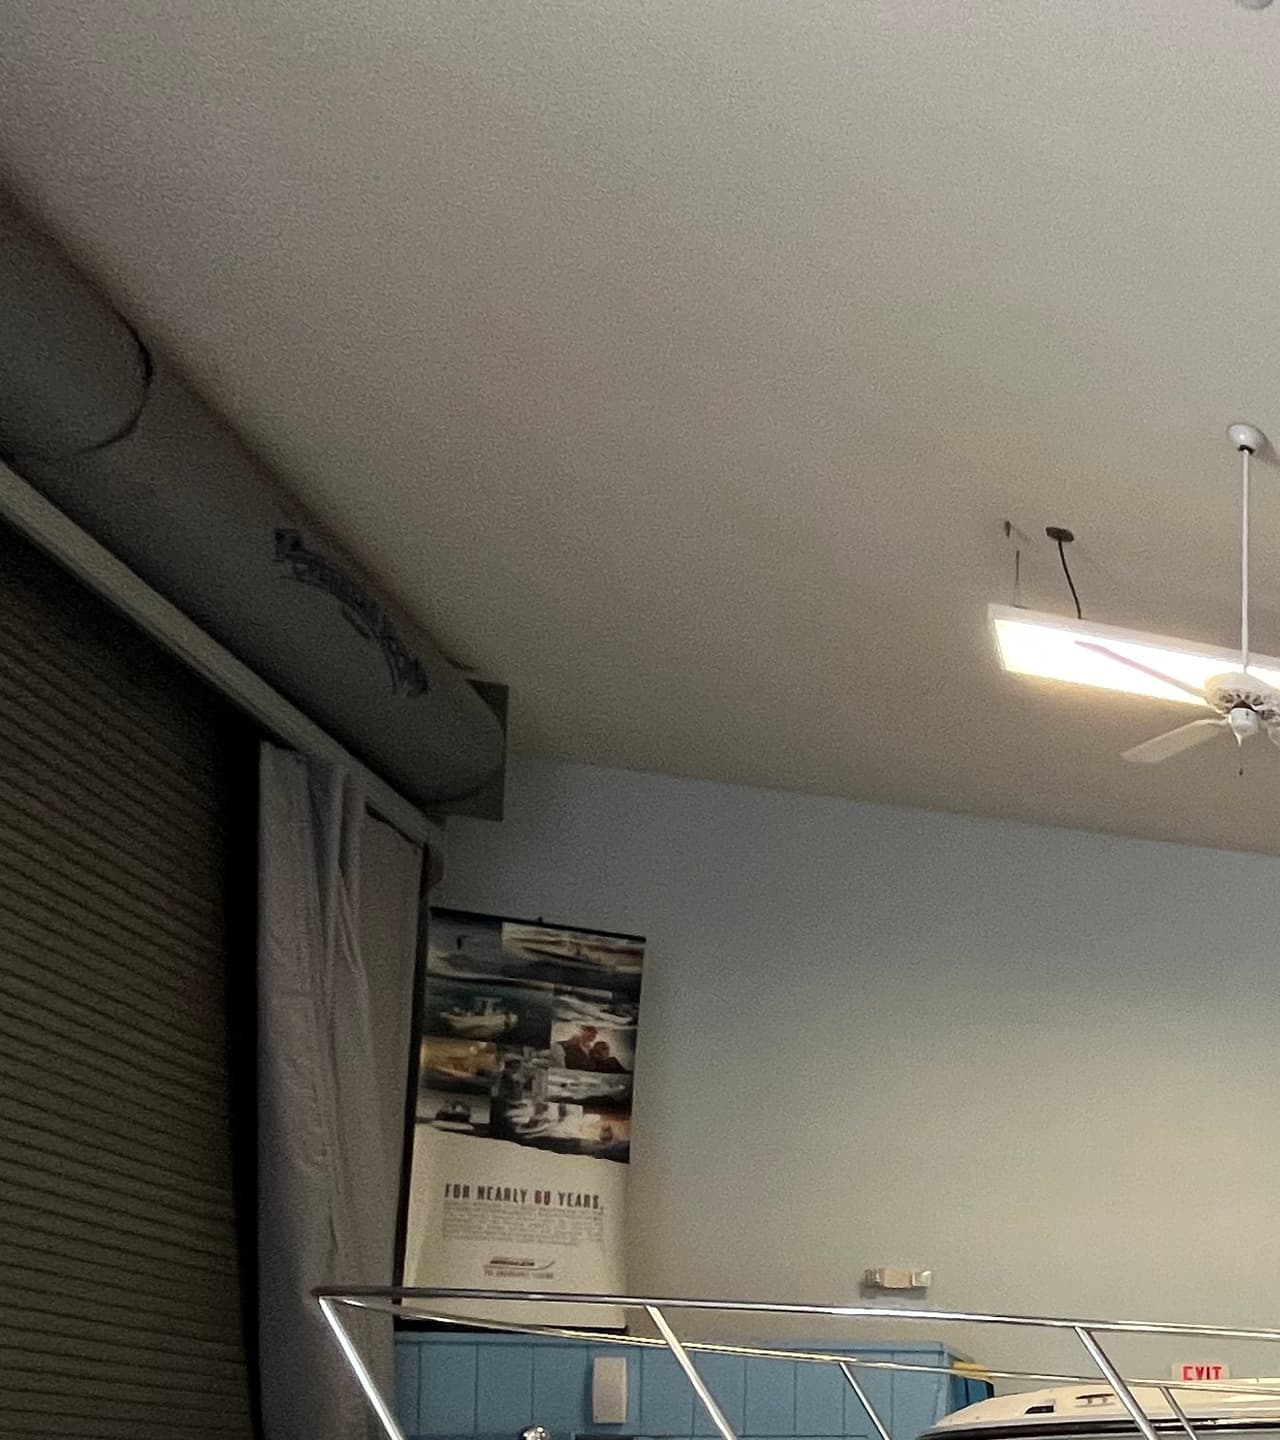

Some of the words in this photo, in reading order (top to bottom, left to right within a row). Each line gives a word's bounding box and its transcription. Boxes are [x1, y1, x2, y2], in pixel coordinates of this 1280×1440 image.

[444, 1183, 471, 1199] FOR
[476, 1185, 528, 1204] NEARLY
[1182, 1365, 1223, 1381] EXIT
